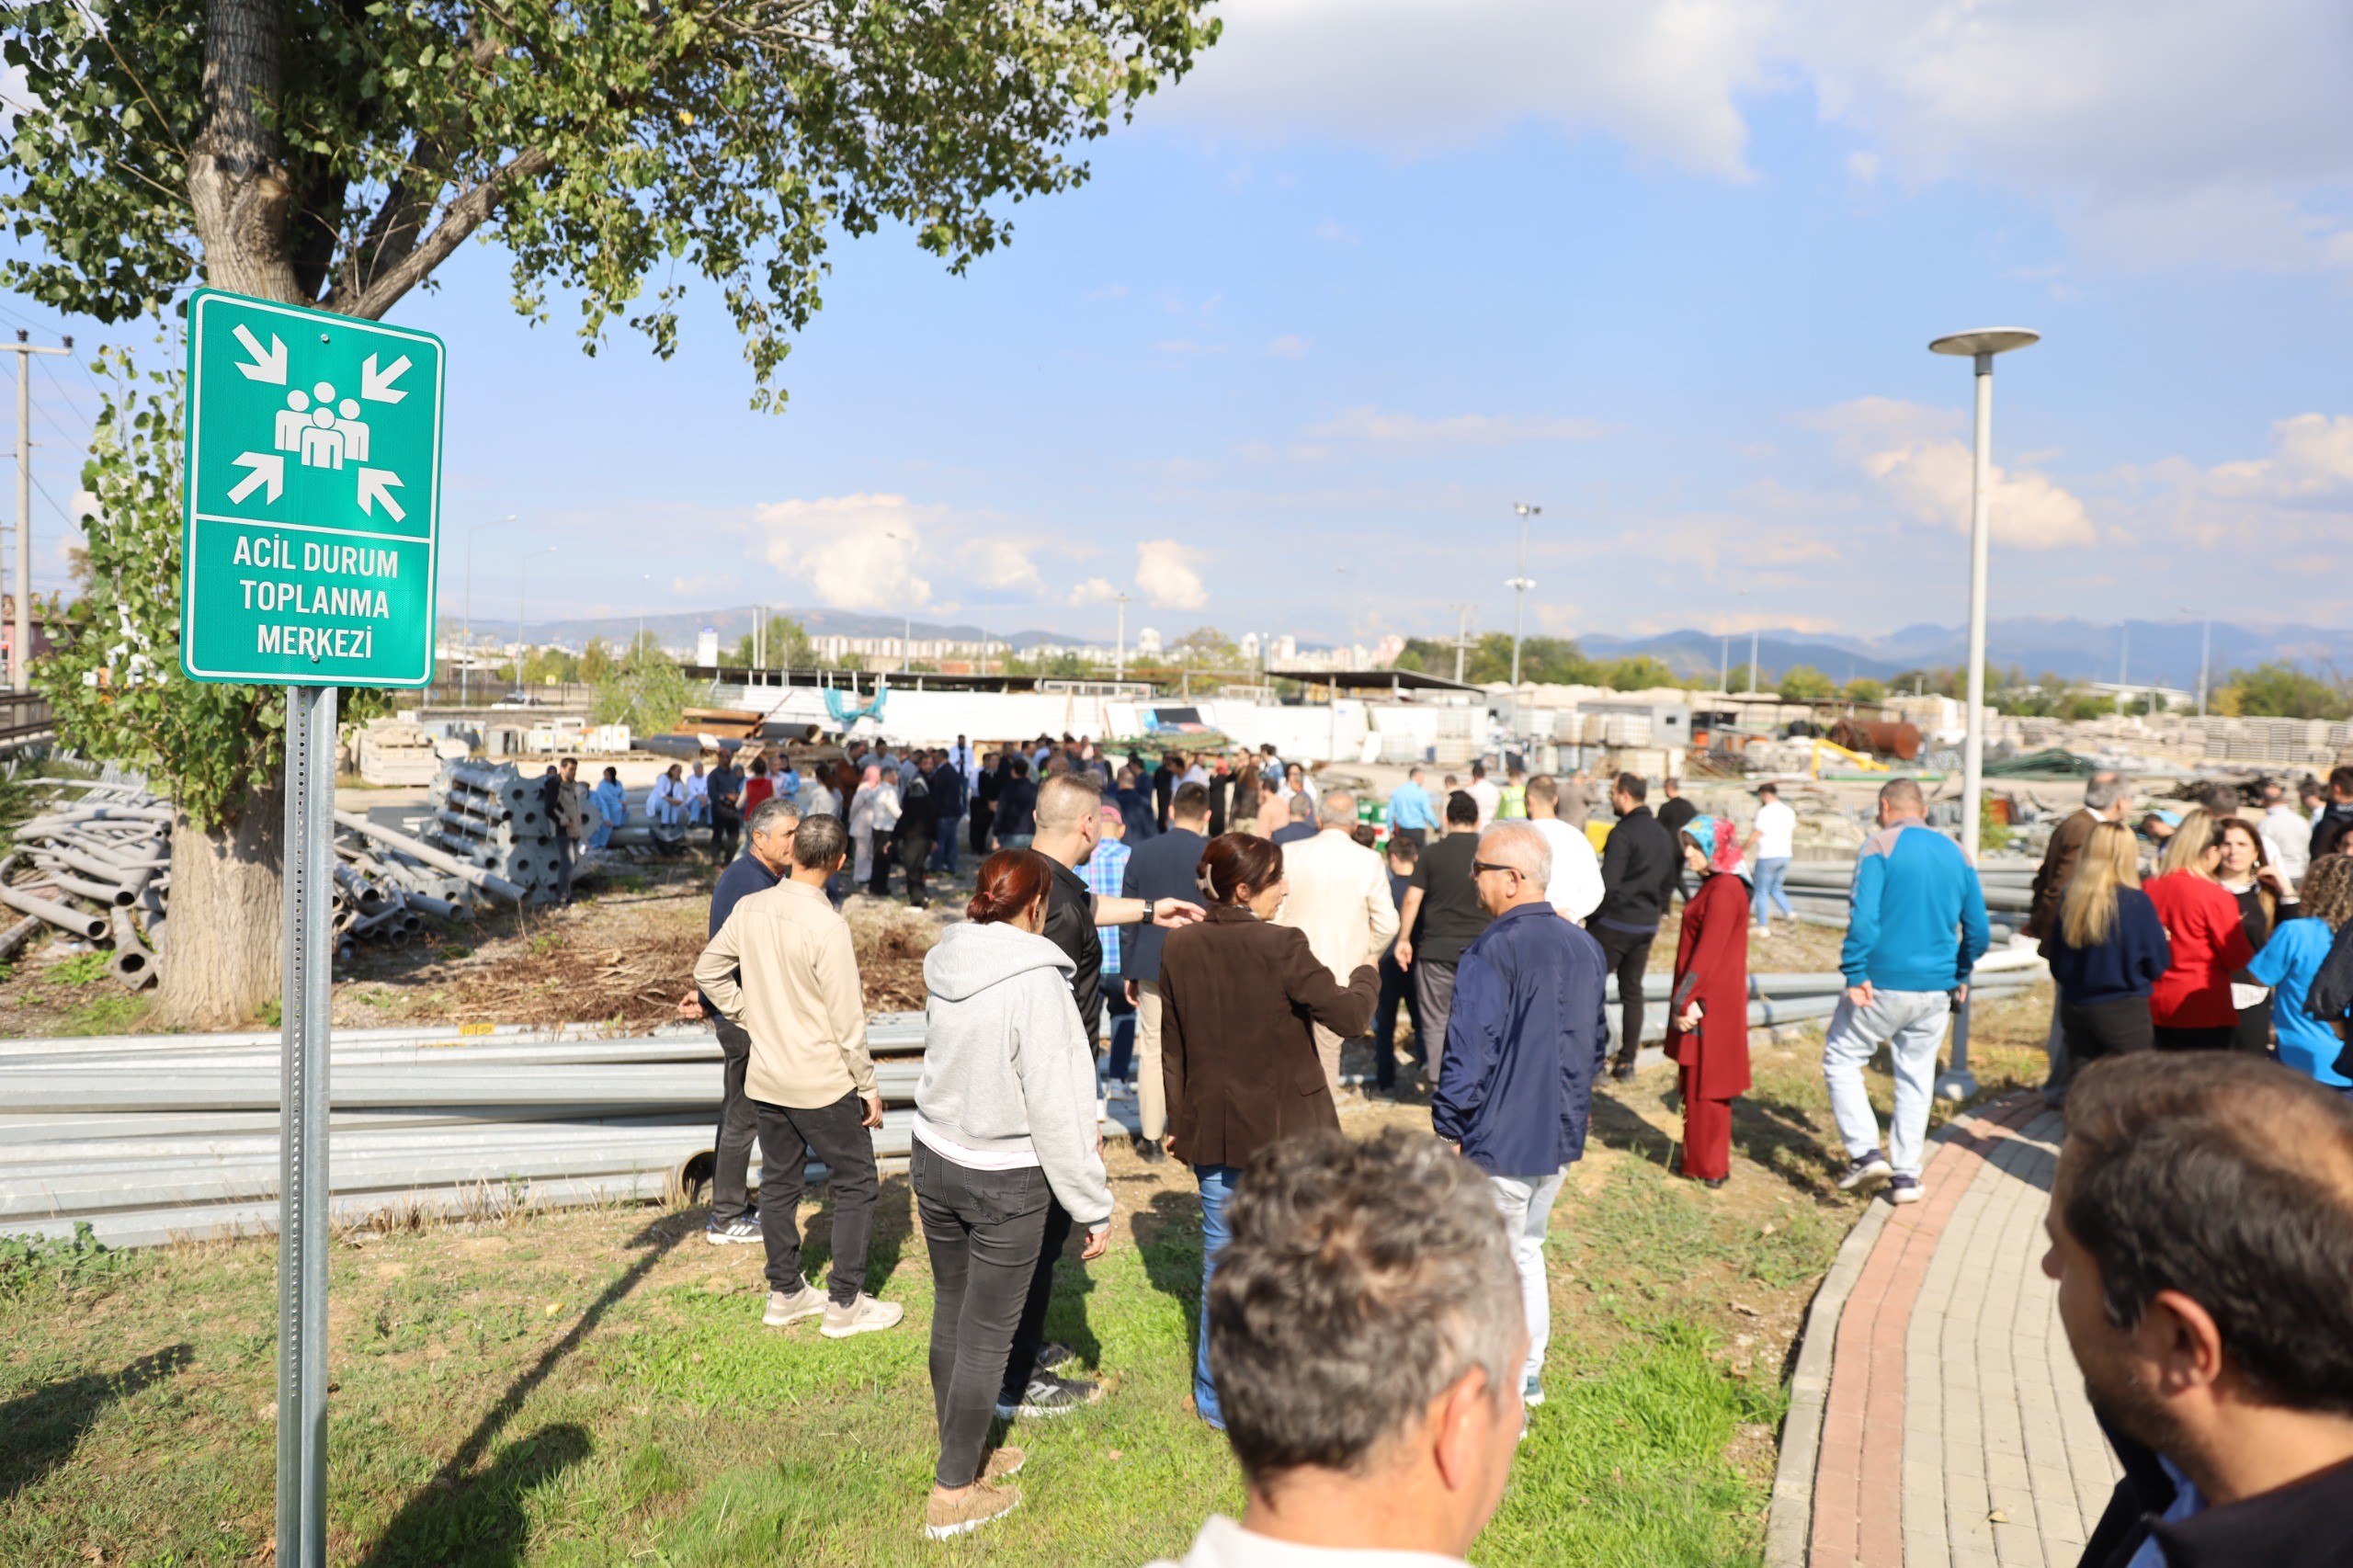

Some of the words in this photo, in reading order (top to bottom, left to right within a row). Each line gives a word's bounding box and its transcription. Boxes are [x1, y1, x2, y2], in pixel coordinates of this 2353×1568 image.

[233, 533, 297, 570] ACİL
[303, 542, 398, 579] DURUM
[239, 579, 390, 619] TOPLANMA
[256, 624, 372, 659] MERKEZİ
